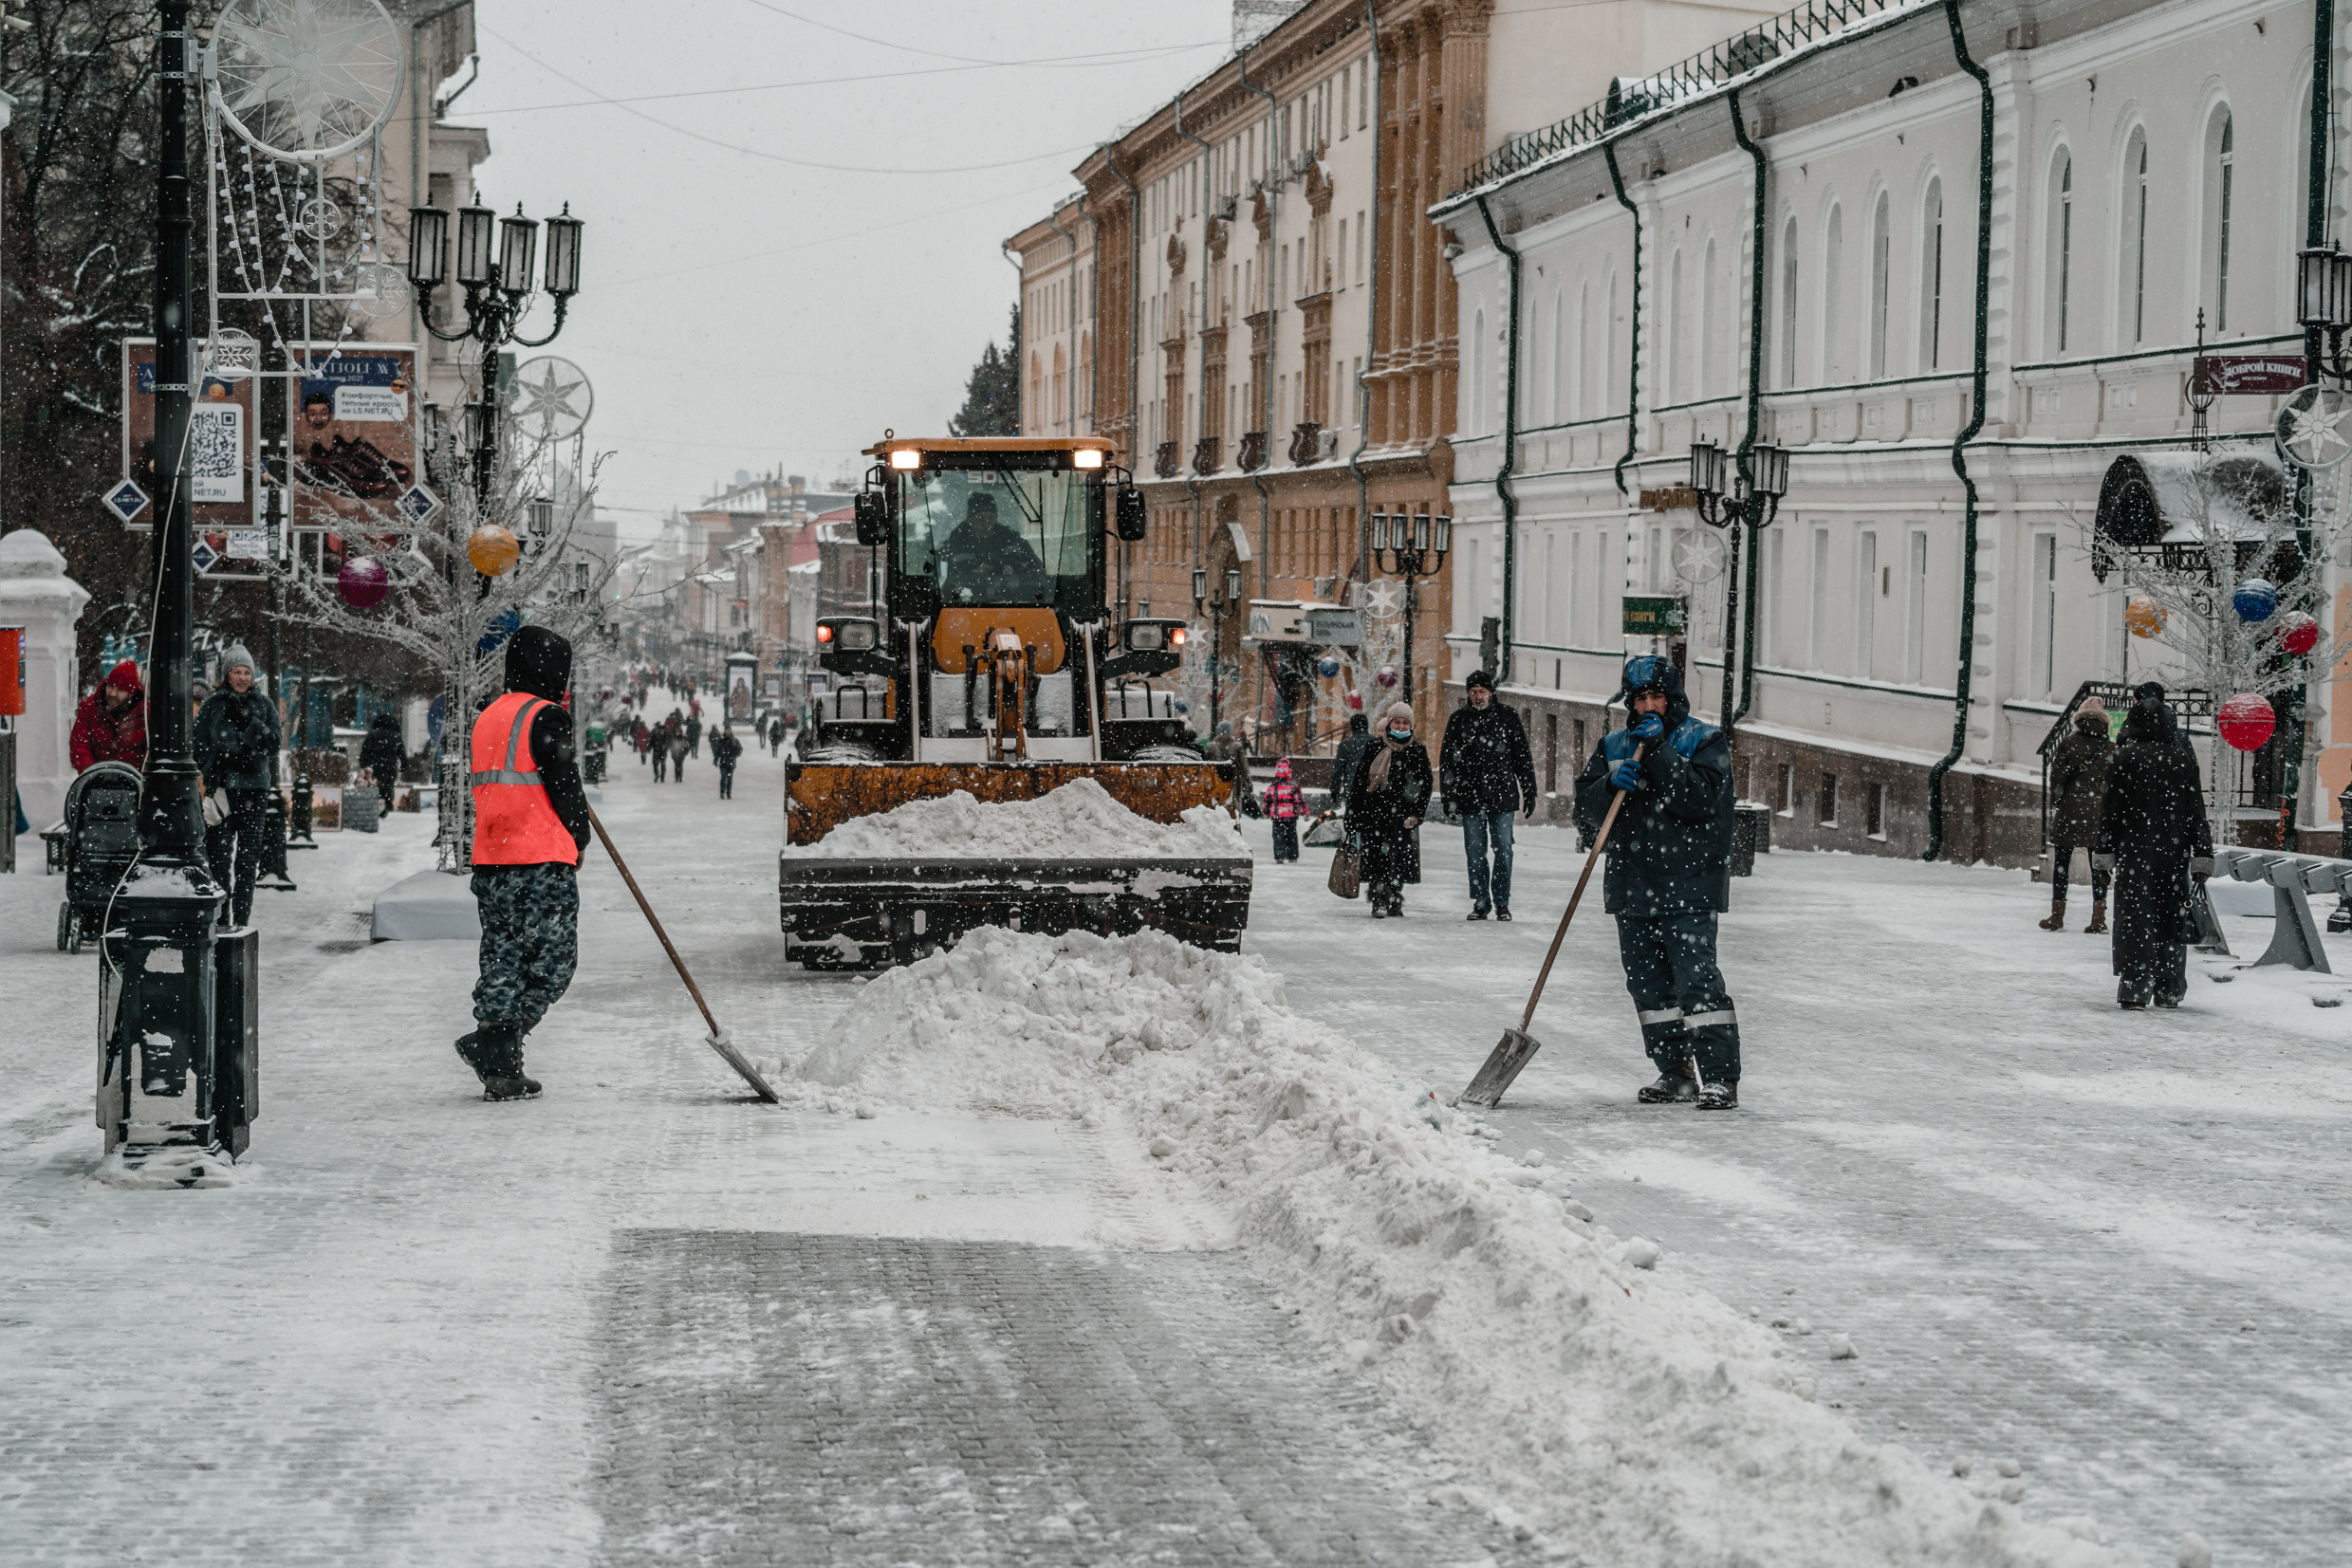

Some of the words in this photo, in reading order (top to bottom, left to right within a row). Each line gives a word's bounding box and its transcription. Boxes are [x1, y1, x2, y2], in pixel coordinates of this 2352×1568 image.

[2226, 360, 2265, 377] ДОБРОЙ
[2267, 362, 2301, 378] КНИГИ
[967, 470, 1028, 483] SDLG
